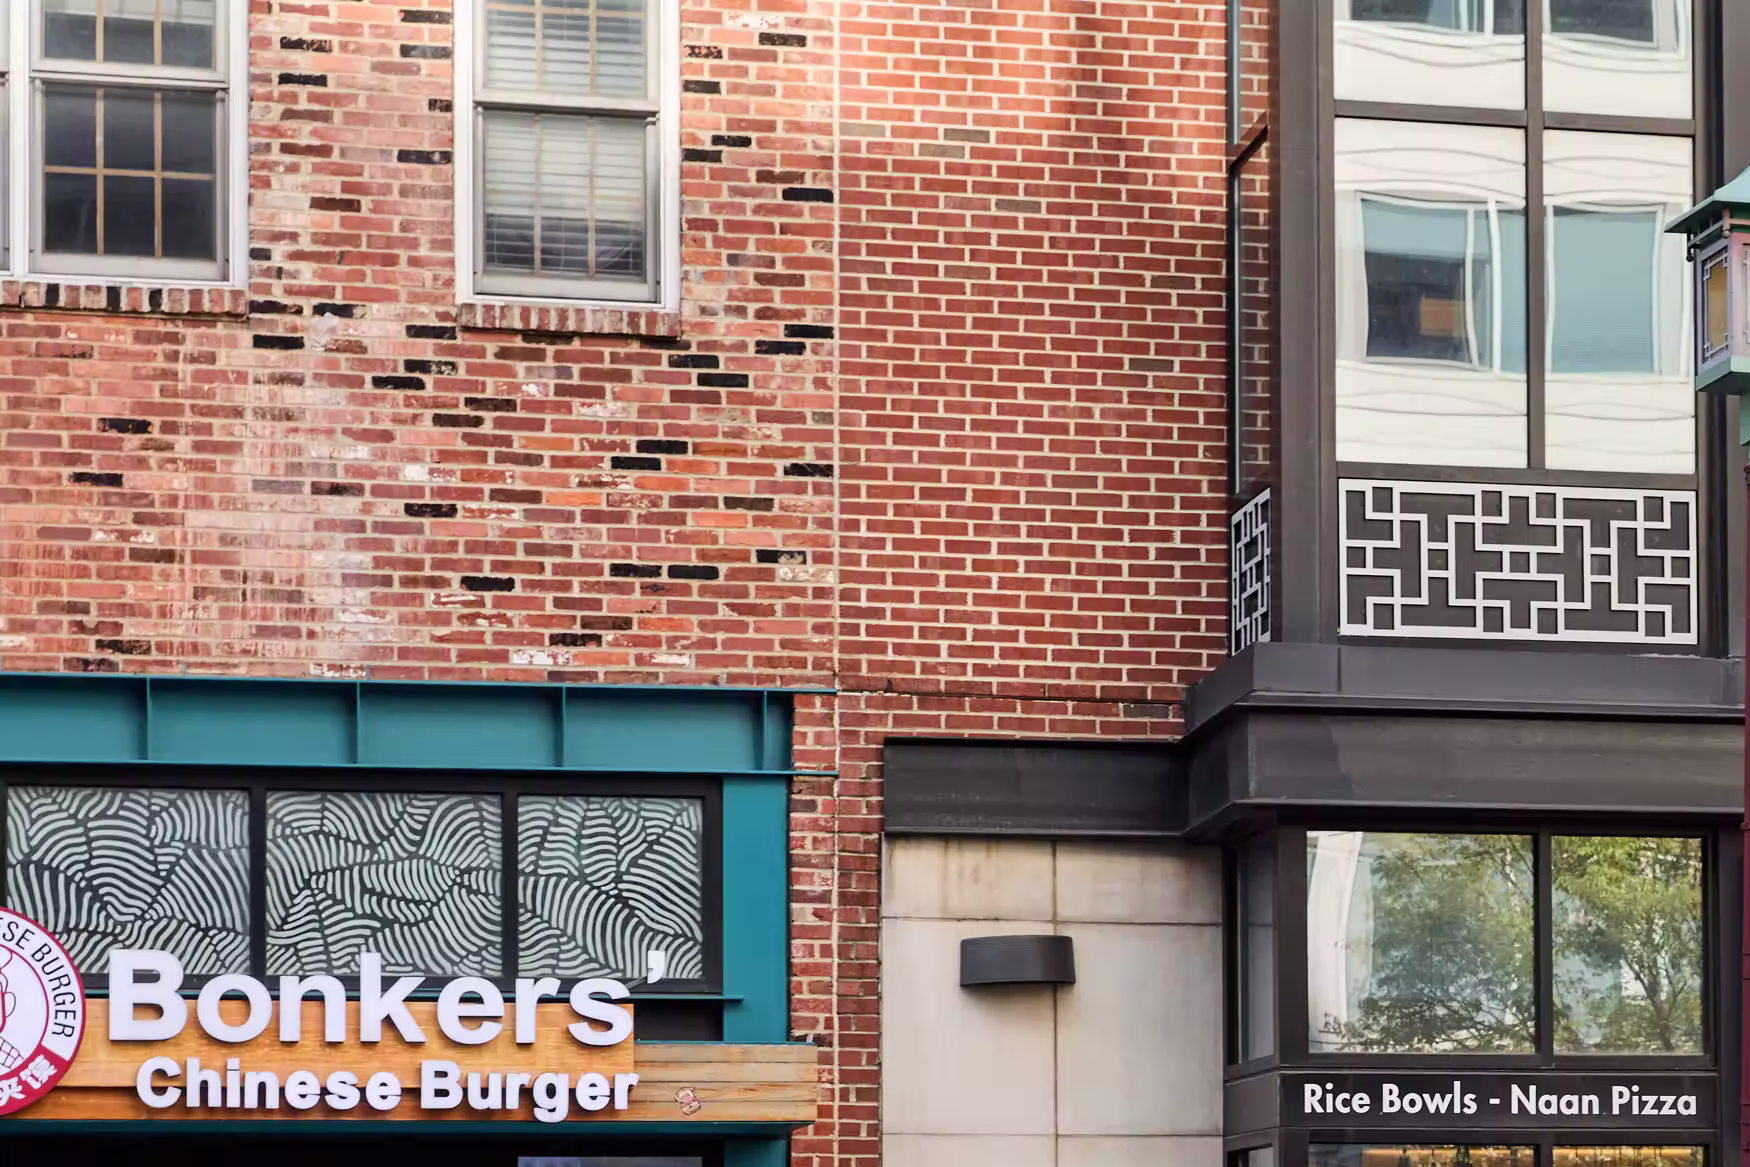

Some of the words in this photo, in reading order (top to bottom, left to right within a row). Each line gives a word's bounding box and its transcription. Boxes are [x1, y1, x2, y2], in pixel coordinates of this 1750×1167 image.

[31, 942, 76, 1038] BURGER
[108, 949, 665, 1047] Bonkers'
[136, 1056, 402, 1112] Chinese
[420, 1059, 640, 1123] Burger
[1304, 1082, 1371, 1115] Rice
[1382, 1080, 1478, 1115] Bowls
[1511, 1083, 1600, 1116] Naan
[1611, 1084, 1698, 1116] Pizza
